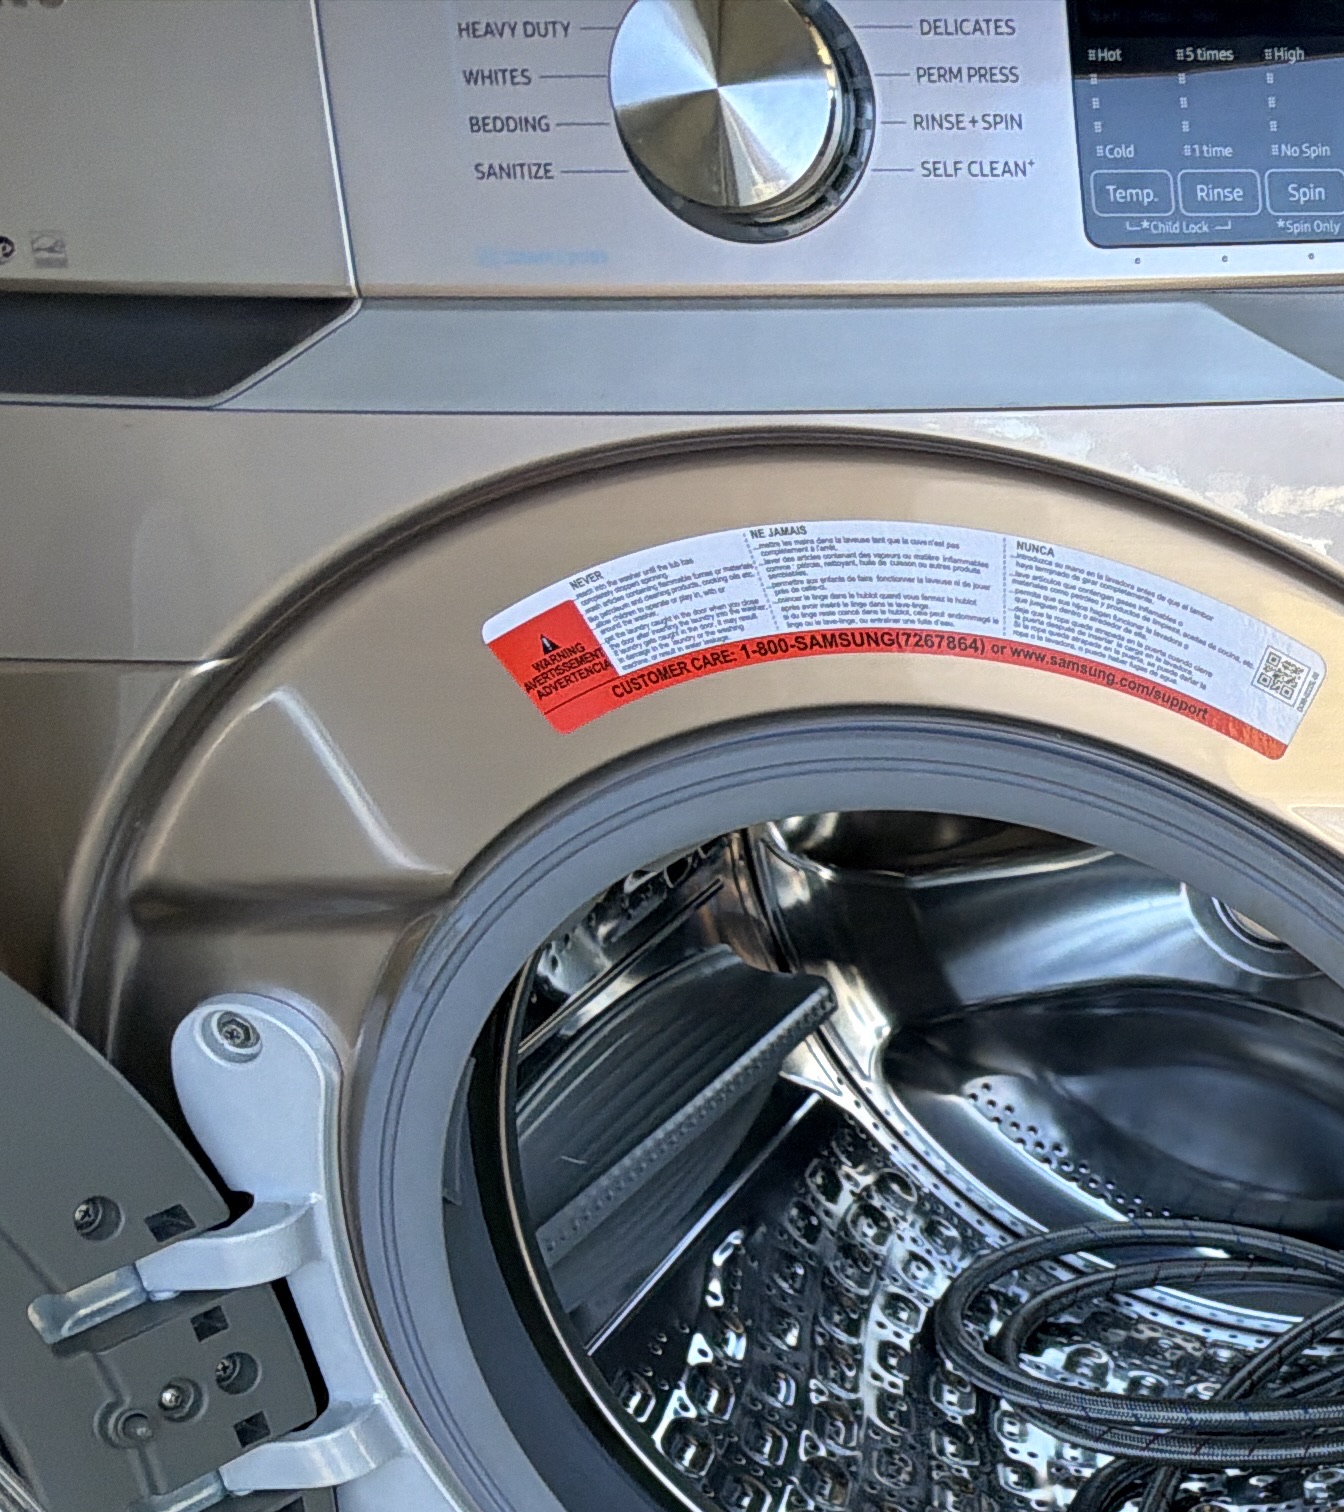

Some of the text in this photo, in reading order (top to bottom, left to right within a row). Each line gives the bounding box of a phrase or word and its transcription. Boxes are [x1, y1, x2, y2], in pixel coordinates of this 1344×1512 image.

[457, 20, 570, 39] HEAVY DUTY
[919, 19, 1016, 35] DELICATES
[1098, 49, 1122, 61] Hot
[1186, 48, 1234, 61] 5 times
[1274, 48, 1304, 64] High
[463, 69, 531, 86] WHITES
[916, 67, 1019, 83] PERM PRESS
[469, 116, 550, 133] BEDDING
[1105, 144, 1135, 158] Cold
[1202, 145, 1233, 157] time
[1281, 143, 1331, 159] No Spin
[474, 163, 555, 180] SANITIZE
[921, 161, 962, 178] SELF
[1106, 185, 1159, 205] Temp.
[1196, 184, 1243, 201] Rinse
[1288, 183, 1326, 204] Spin
[1182, 220, 1209, 233] Lock
[1317, 220, 1341, 235] Only
[750, 526, 807, 539] NE JAMAIS
[1016, 540, 1055, 557] NUNCA
[568, 571, 604, 590] NEVER
[531, 642, 586, 672] WARNING
[523, 647, 606, 695] AVERTISSEMENT
[535, 658, 612, 701] ADVERTENCIA
[611, 632, 1209, 720] CUSTOMER CARE: 1-800-SAMSUNG(7267864) or www.samsung.com/support
